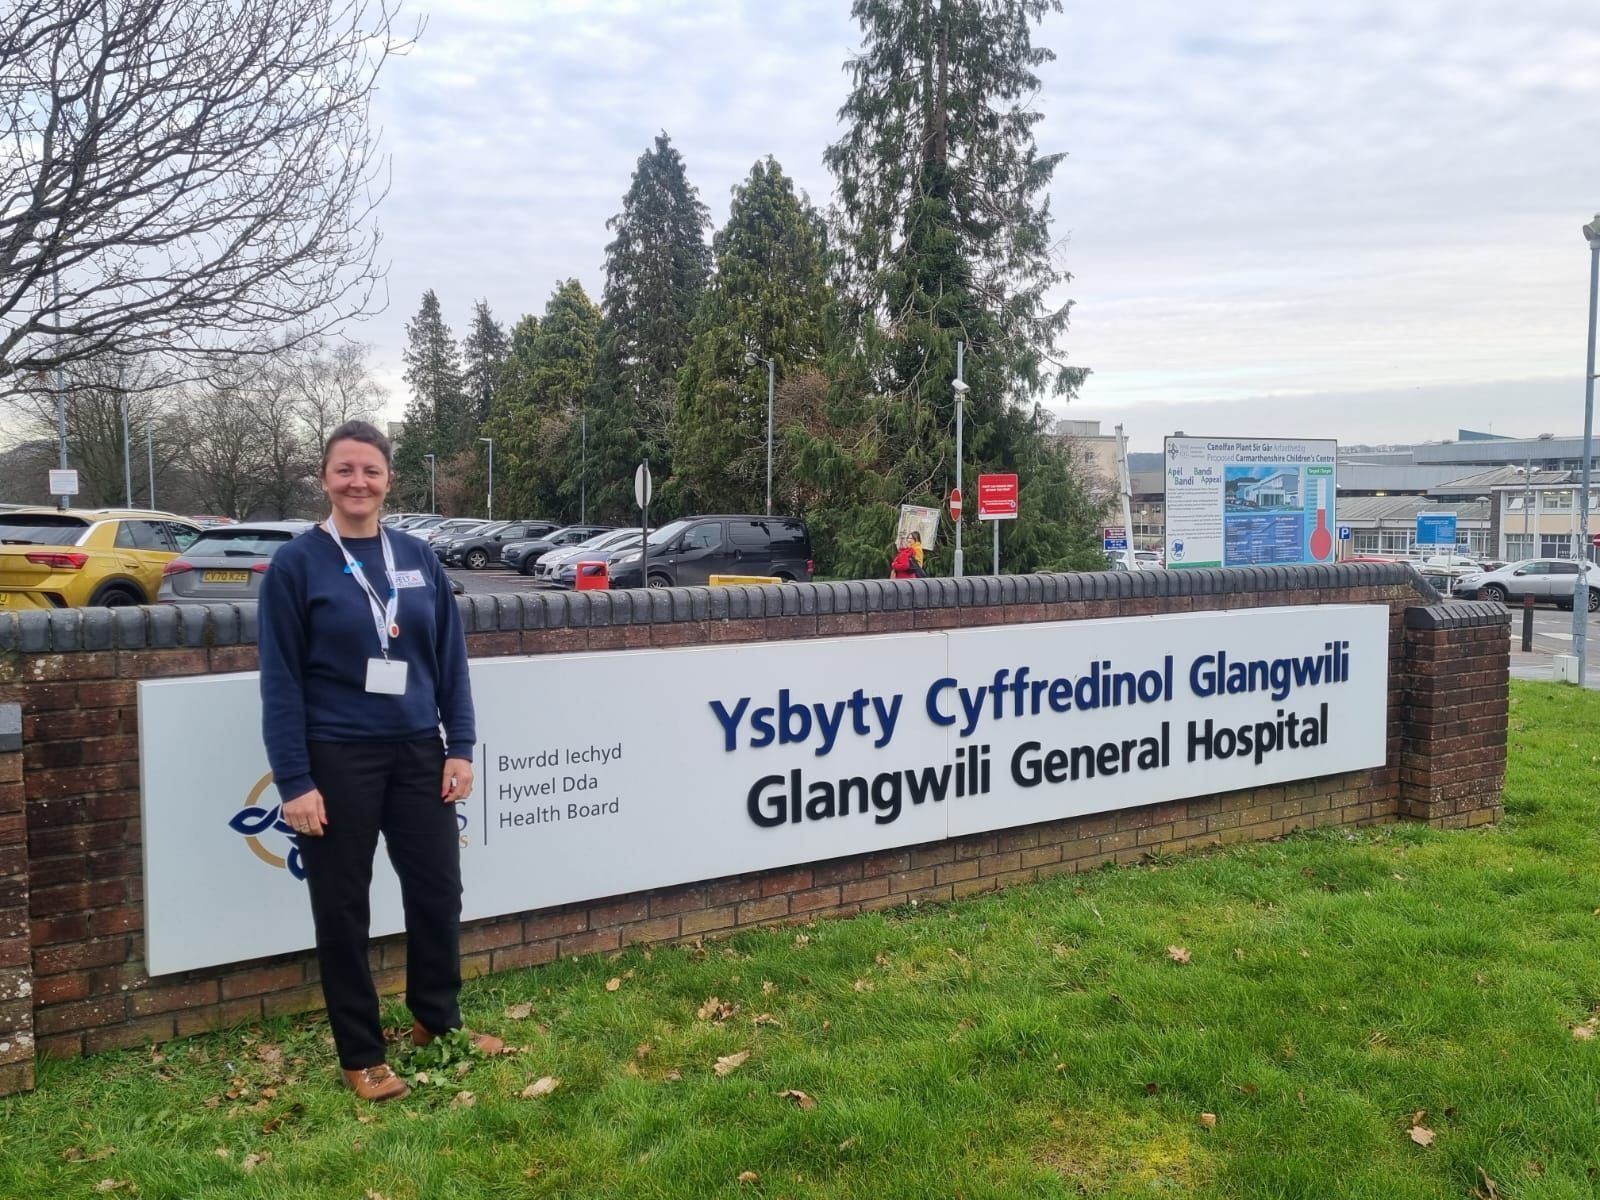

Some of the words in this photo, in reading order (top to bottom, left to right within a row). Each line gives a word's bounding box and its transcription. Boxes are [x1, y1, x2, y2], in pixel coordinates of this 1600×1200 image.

[1207, 442, 1235, 451] Canolfan
[1236, 442, 1252, 451] Plant
[1253, 443, 1261, 452] Sir
[1236, 453, 1285, 462] Carmarthenshire
[1316, 454, 1335, 462] Centre
[1201, 475, 1222, 485] Appeal
[1341, 528, 1349, 539] P
[709, 688, 903, 757] Ysbyty
[926, 655, 1173, 737] Cyffredinol
[1189, 641, 1349, 702] Glangwili
[498, 749, 559, 772] Bwrdd
[566, 742, 622, 766] Iechyd
[747, 744, 991, 828] Glangwili
[1011, 721, 1170, 788] General
[1187, 702, 1328, 766] Hospital
[499, 777, 556, 803] Hywel
[563, 773, 598, 793] Dda
[500, 805, 561, 829] Health
[567, 797, 619, 820] Board
